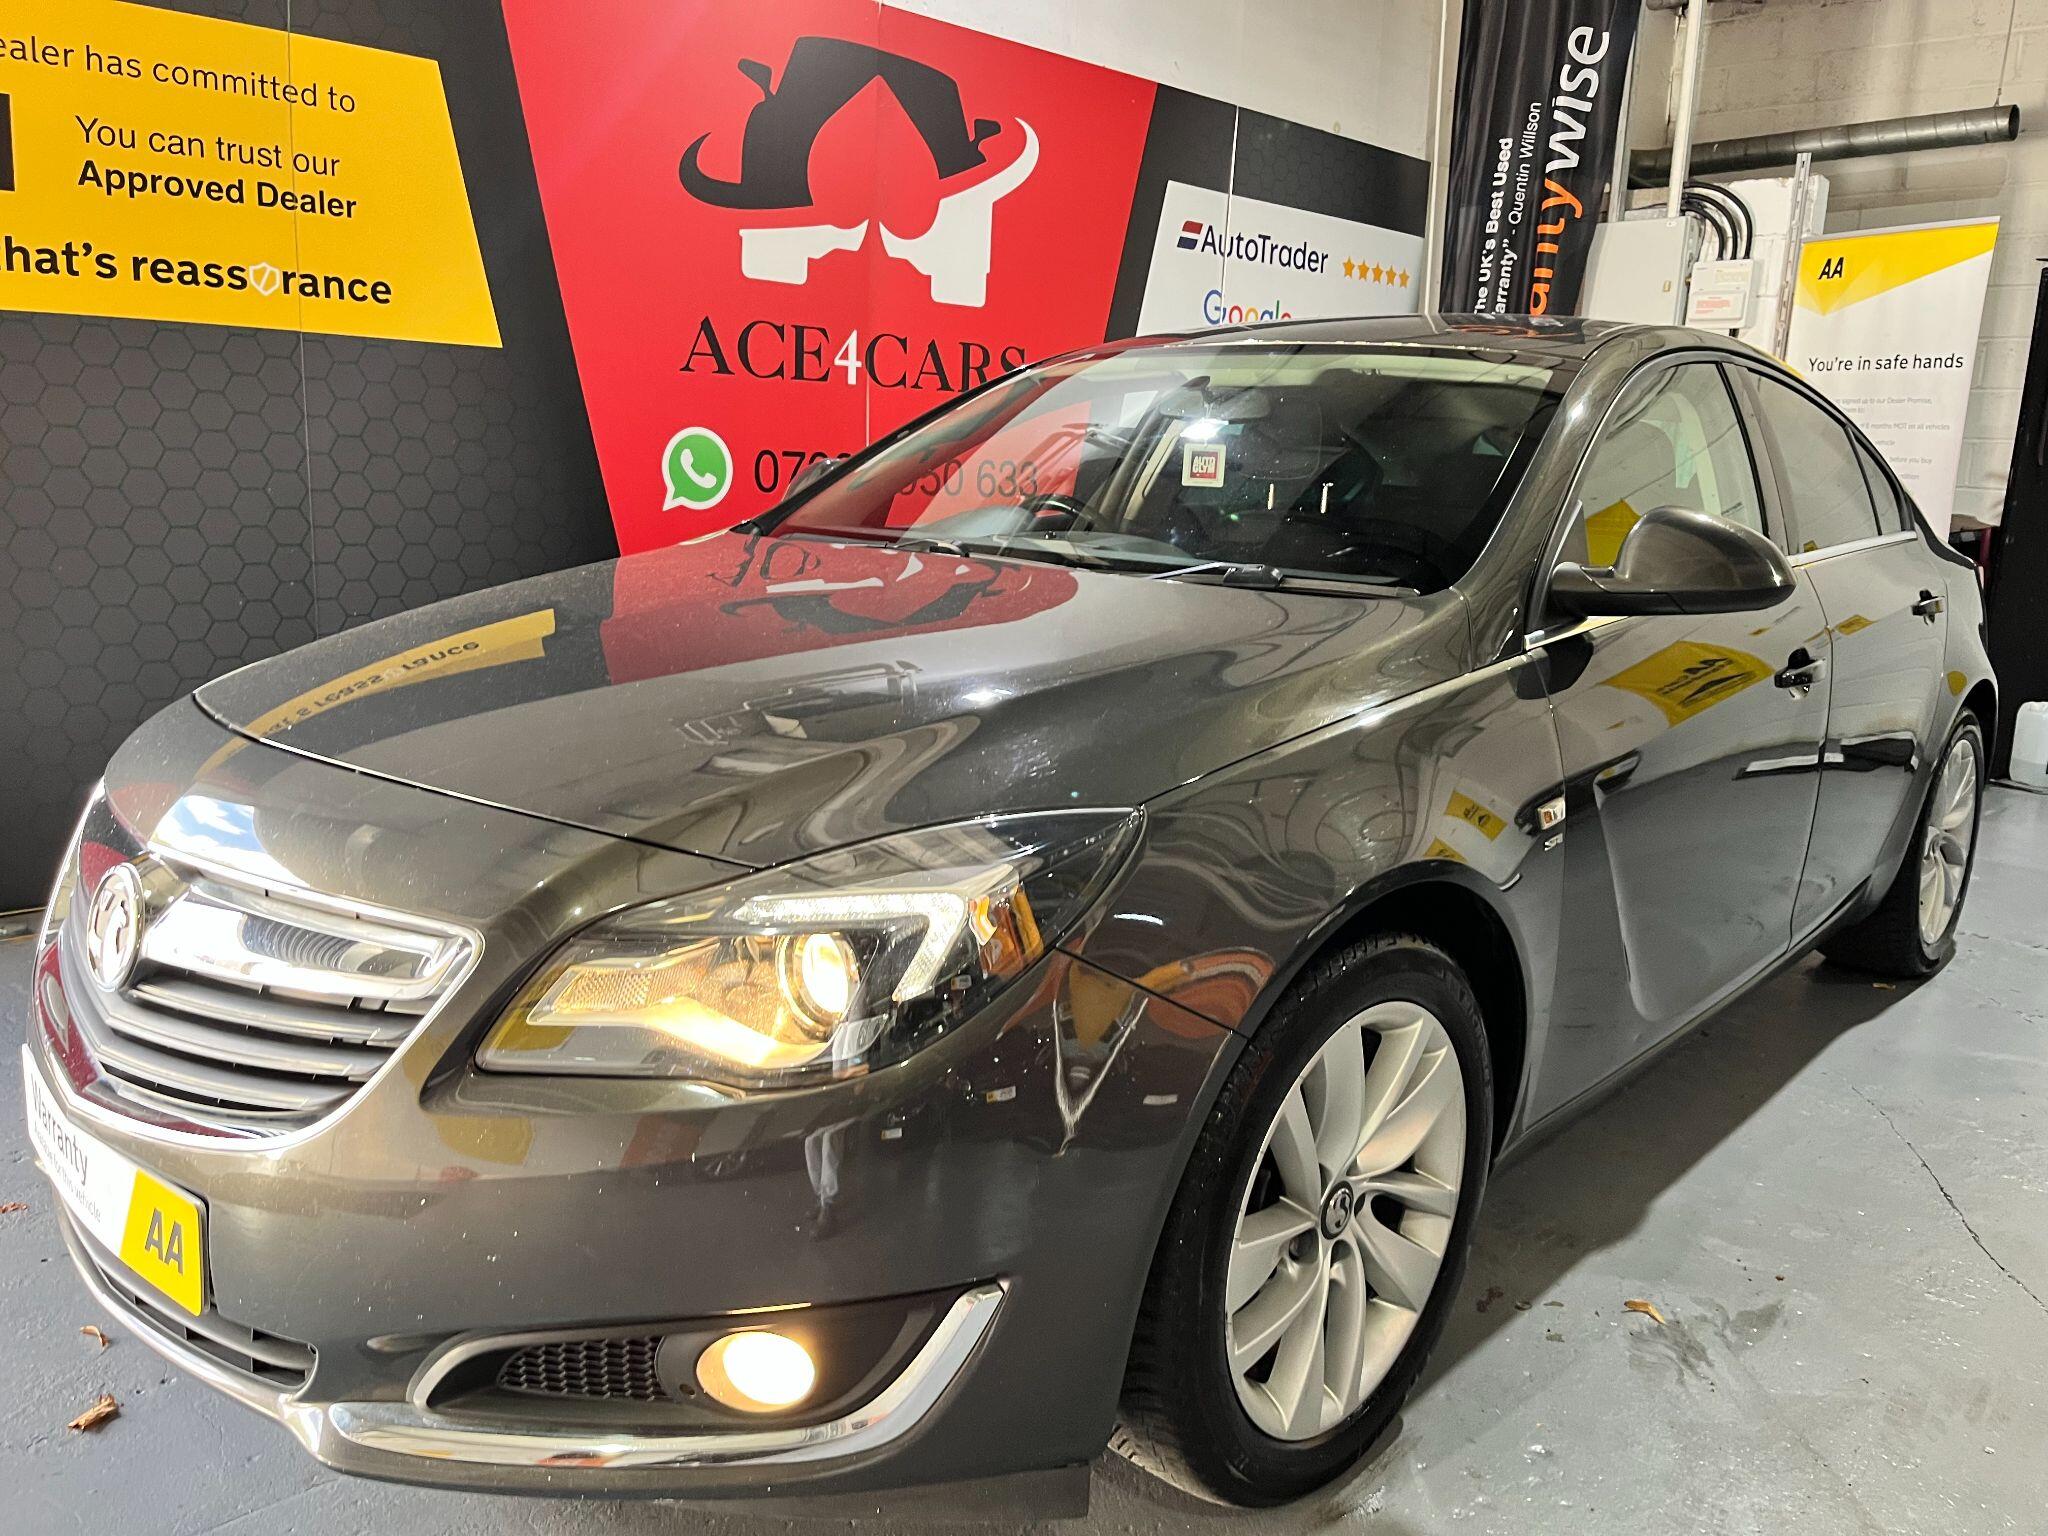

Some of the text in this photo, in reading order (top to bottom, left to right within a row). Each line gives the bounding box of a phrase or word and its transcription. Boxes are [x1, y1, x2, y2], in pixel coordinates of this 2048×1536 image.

[86, 44, 142, 78] has
[152, 62, 317, 107] committed
[327, 86, 356, 113] to
[75, 115, 340, 176] You can trust our
[1518, 102, 1542, 159] Willson
[78, 160, 357, 218] Approved Dealer
[1508, 163, 1532, 225] Quentin
[1201, 225, 1328, 273] AutoTrader
[1473, 137, 1513, 315] he UK's Best Used
[0, 236, 117, 279] hat’s
[1491, 238, 1518, 315] arranty”
[1818, 257, 1844, 280] AA
[1203, 289, 1291, 325] Gool
[680, 316, 1025, 393] ACE4CARS
[1808, 353, 1964, 373] You're in safe hands
[31, 1073, 87, 1186] Warranty
[145, 1207, 184, 1275] AA
